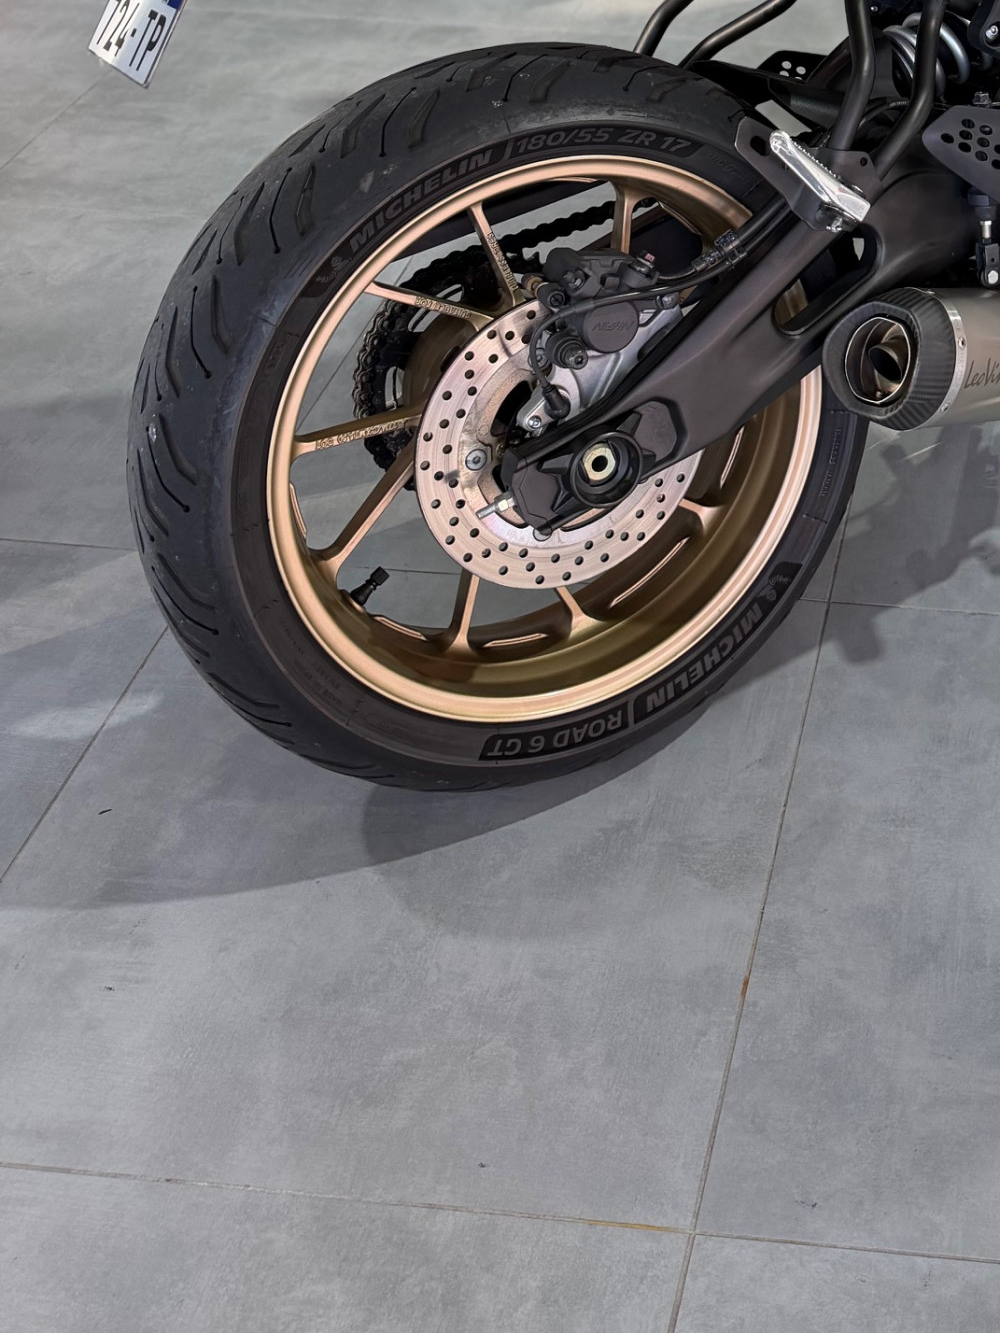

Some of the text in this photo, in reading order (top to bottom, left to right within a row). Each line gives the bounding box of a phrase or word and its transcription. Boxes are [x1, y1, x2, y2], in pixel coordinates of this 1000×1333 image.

[516, 127, 692, 155] 180/55 ZR 17
[349, 149, 492, 254] MICHELIN
[645, 600, 765, 714] MICHELIN
[487, 709, 623, 757] ROAD 6 GT
